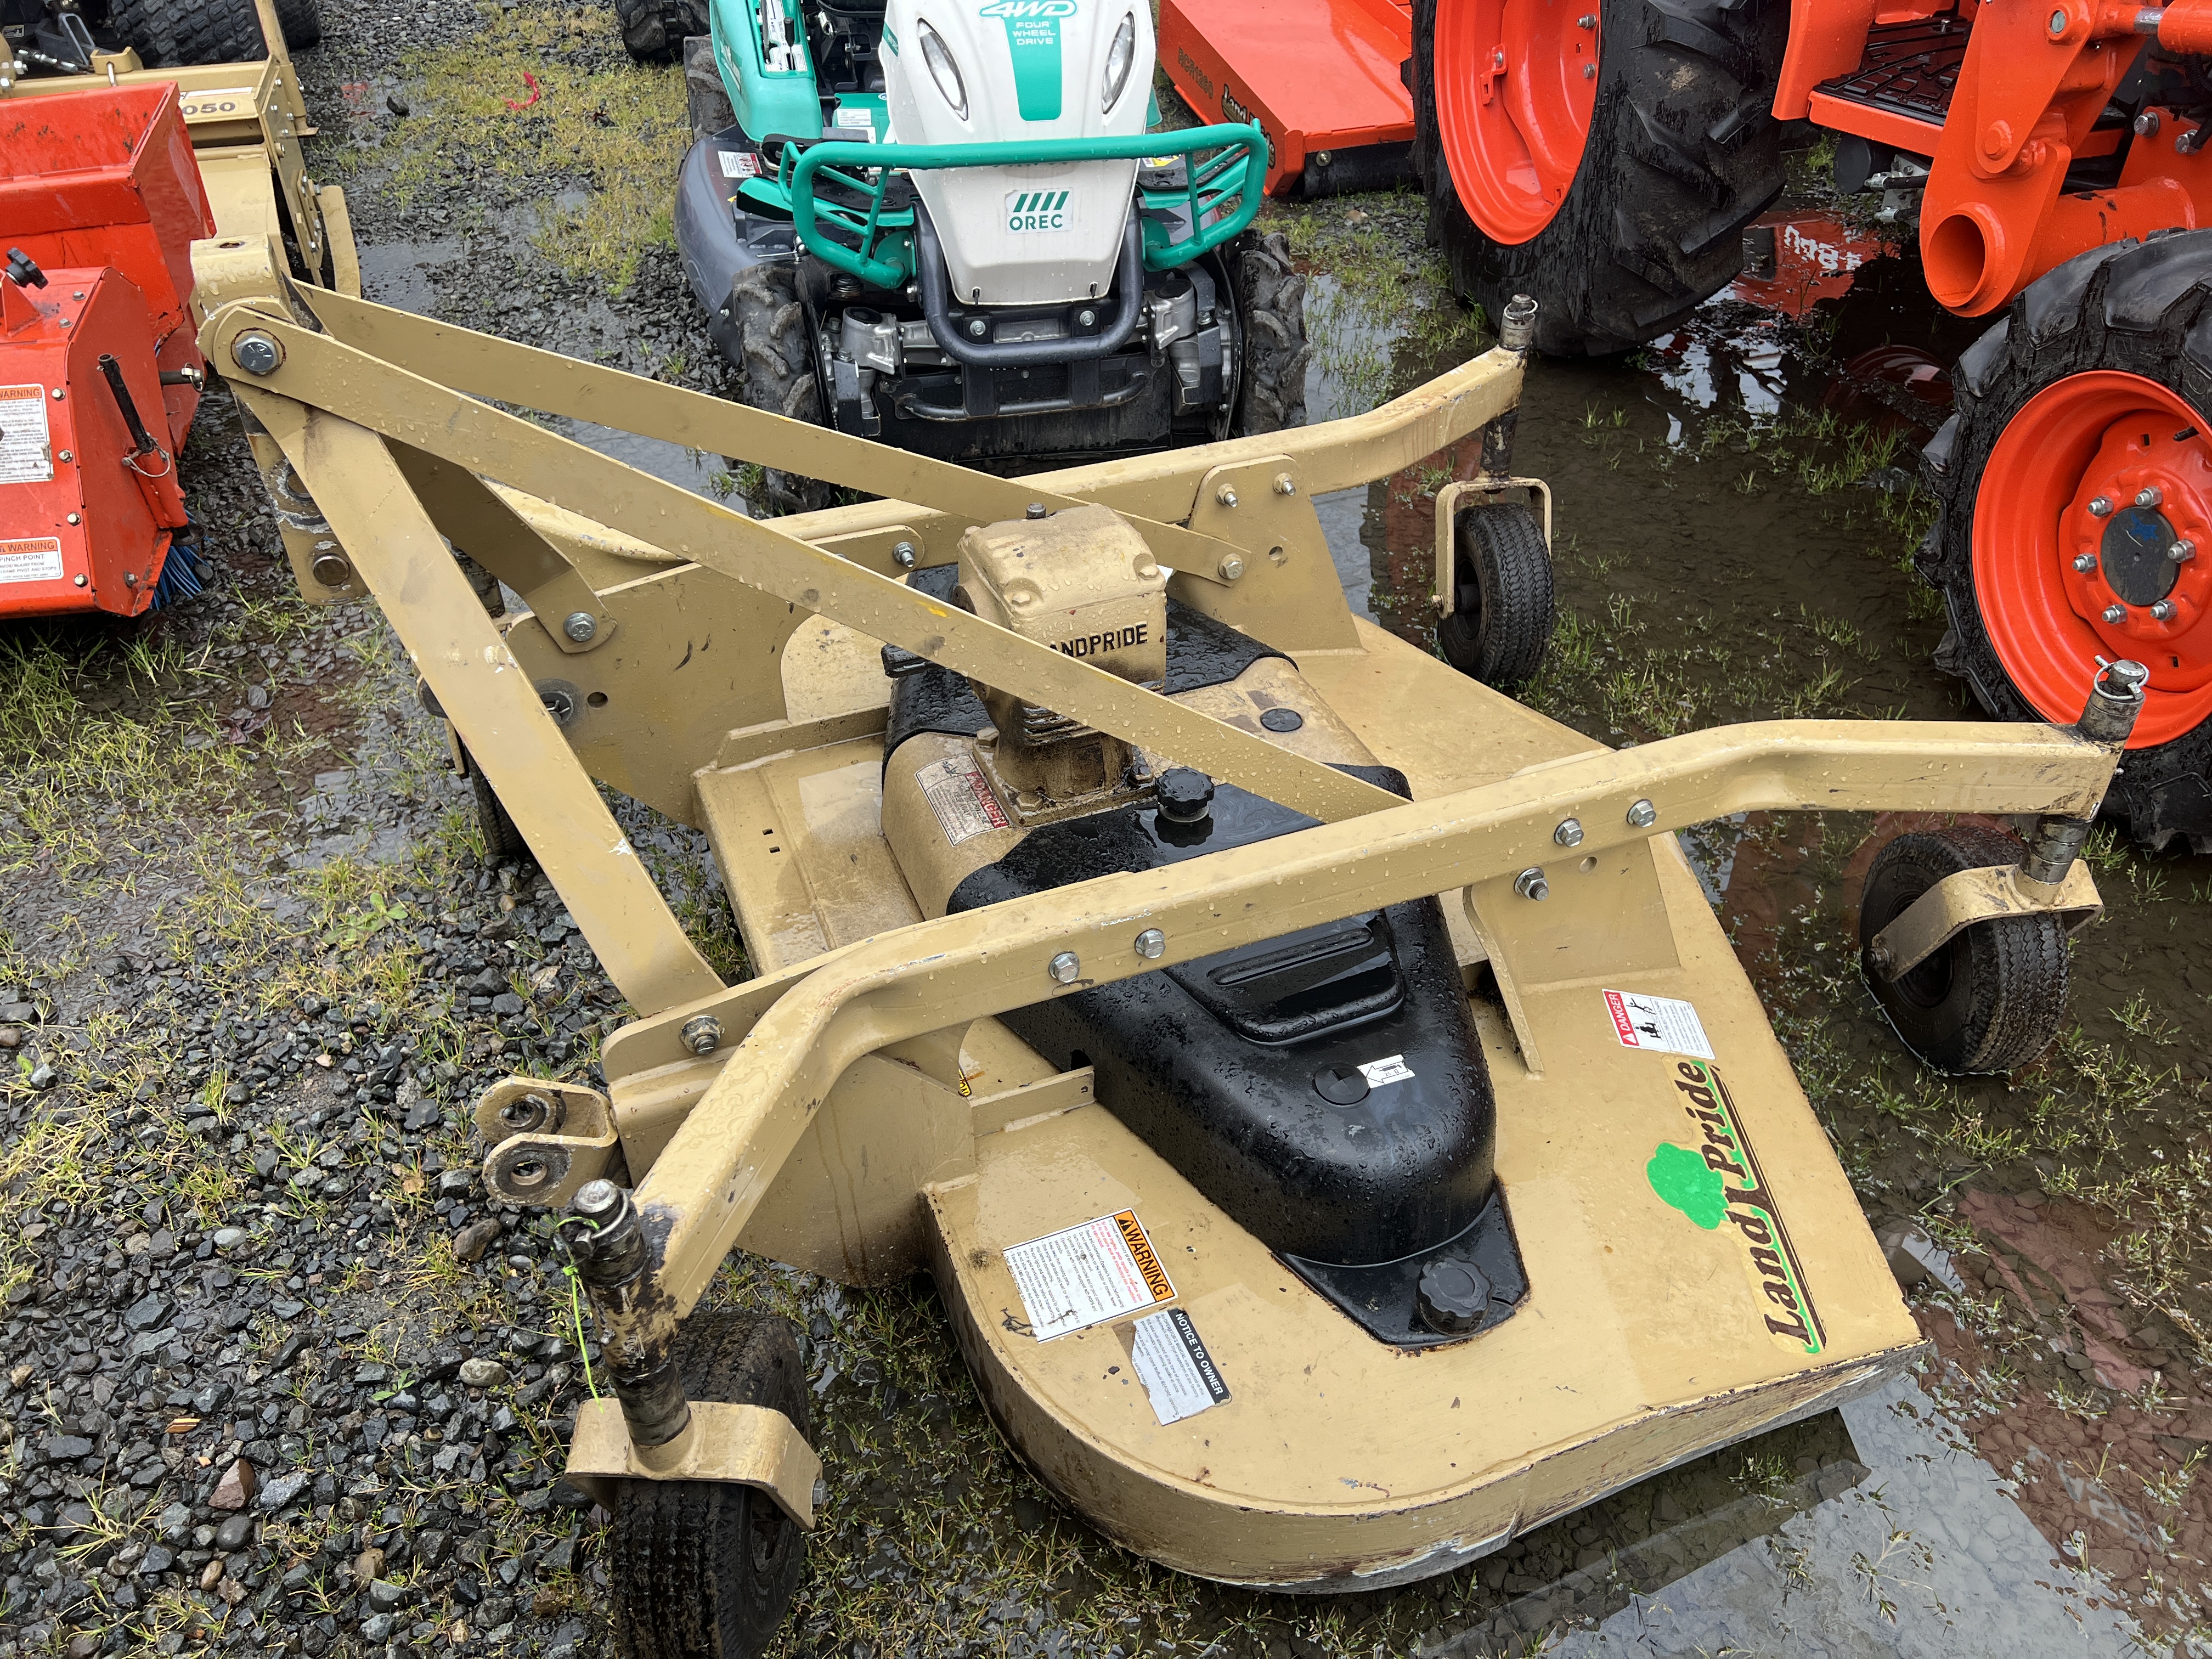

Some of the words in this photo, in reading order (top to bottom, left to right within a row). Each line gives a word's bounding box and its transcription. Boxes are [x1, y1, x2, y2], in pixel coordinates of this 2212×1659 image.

[980, 0, 1077, 18] 4WD
[1177, 47, 1214, 99] RCR1260
[1009, 214, 1063, 231] OREC
[8, 541, 54, 552] WARNING
[973, 780, 1007, 828] DANGER
[1607, 992, 1631, 1031] DANGER
[1675, 1061, 1747, 1179] Pride
[1123, 1227, 1170, 1296] WARNING
[1725, 1209, 1812, 1345] Land
[1174, 1313, 1199, 1346] NOTICE
[1191, 1345, 1206, 1359] TO
[1160, 1380, 1171, 1397] BEFORE
[1198, 1359, 1224, 1395] OWNER
